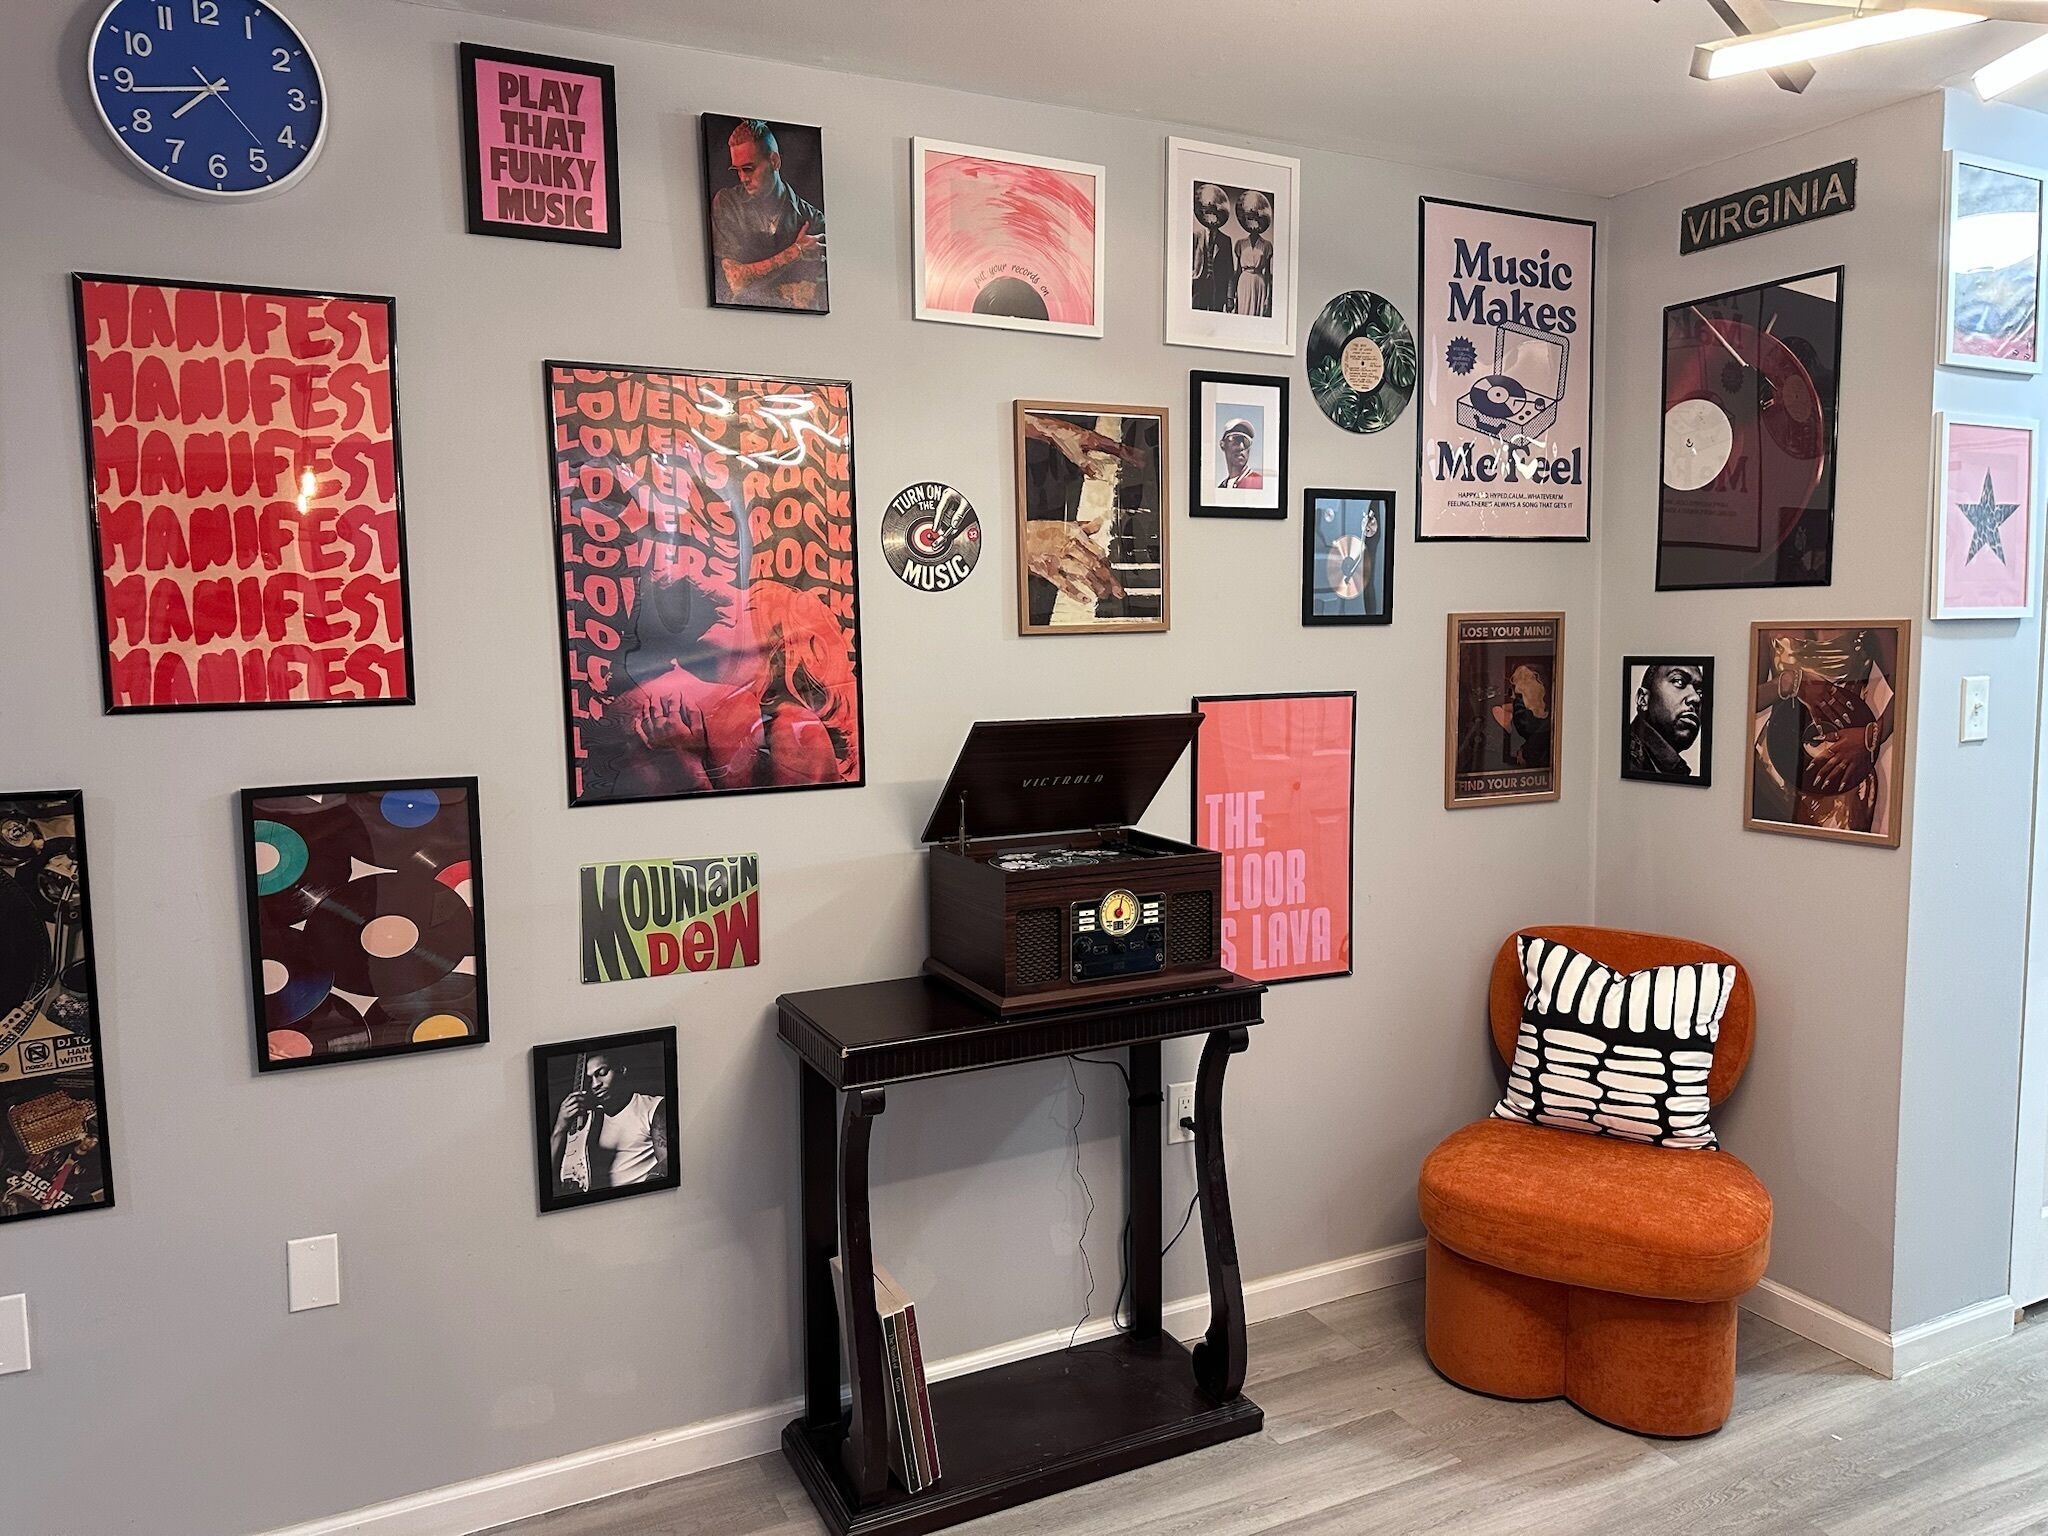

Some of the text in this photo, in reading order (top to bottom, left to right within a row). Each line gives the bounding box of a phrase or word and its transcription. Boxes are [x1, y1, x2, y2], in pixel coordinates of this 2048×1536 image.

[157, 6, 173, 31] 11
[192, 0, 220, 26] 12
[245, 16, 252, 40] 1
[124, 31, 153, 57] 10
[272, 48, 291, 73] 2
[113, 67, 134, 92] 9
[287, 88, 306, 112] 3
[498, 71, 584, 116] PLAY
[132, 109, 153, 133] 8
[500, 109, 585, 153] THAT
[277, 125, 296, 149] 4
[165, 138, 186, 164] 7
[249, 148, 268, 173] 5
[208, 154, 228, 179] 6
[490, 146, 597, 192] FUNKY
[497, 186, 594, 229] MUSIC
[1687, 172, 1848, 246] VIRGINIA
[1453, 238, 1573, 291] Music
[1447, 281, 1577, 334] Makes
[1435, 441, 1498, 483] Me
[892, 484, 943, 516] TURN ON
[918, 500, 936, 511] THE
[748, 497, 852, 552] ROCK
[749, 538, 854, 586] ROCK
[901, 554, 970, 591] MUSIC
[1462, 625, 1553, 638] LOSE YOUR MIND
[1023, 774, 1104, 788] VICTROLA
[1460, 774, 1548, 792] FIND YOUR SOUL
[1205, 790, 1265, 852] THE
[1225, 848, 1306, 912] LOOR
[1221, 906, 1331, 973] S LAVA
[57, 1037, 71, 1048] DJ
[59, 1054, 87, 1065] WITH
